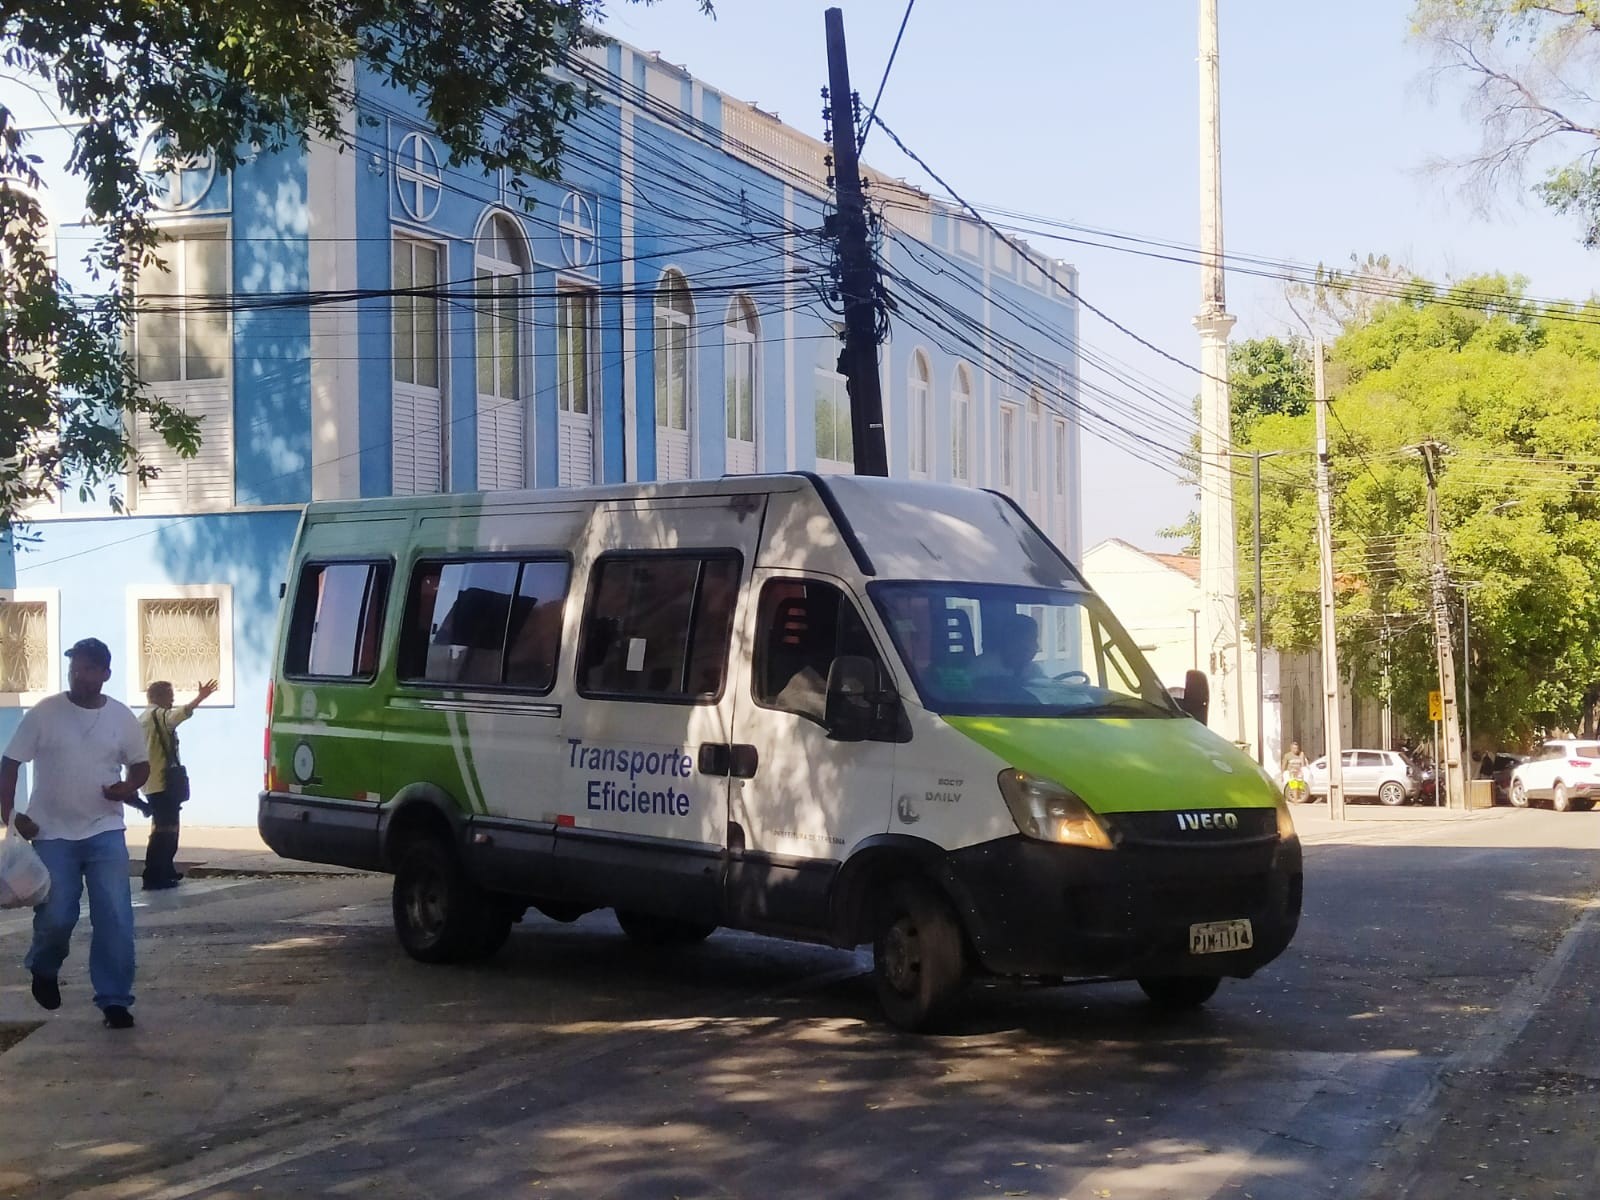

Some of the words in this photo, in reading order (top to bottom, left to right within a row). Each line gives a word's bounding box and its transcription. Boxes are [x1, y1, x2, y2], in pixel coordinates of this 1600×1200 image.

[568, 738, 692, 781] Transporte
[587, 781, 690, 817] Eficiente
[1176, 812, 1239, 831] IVECO
